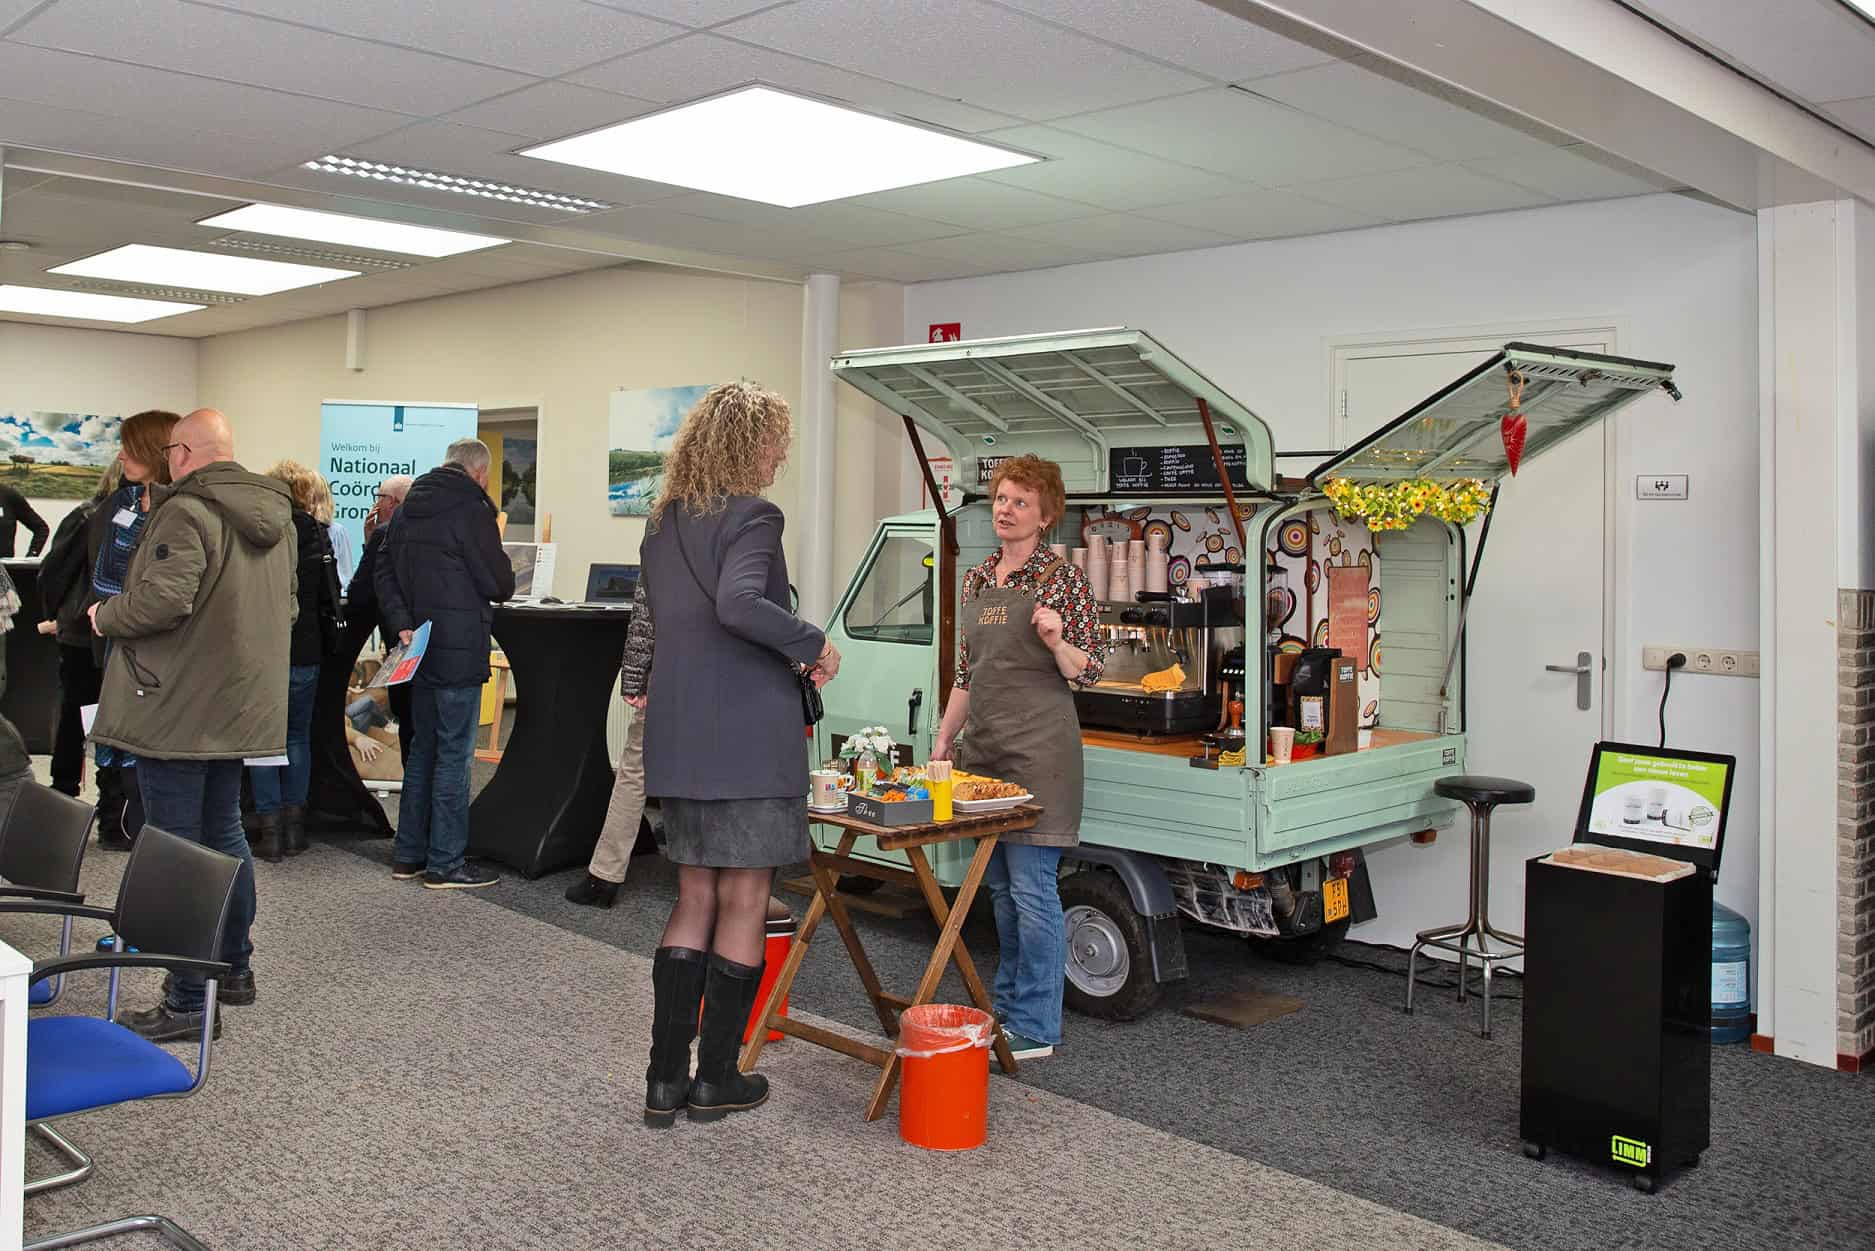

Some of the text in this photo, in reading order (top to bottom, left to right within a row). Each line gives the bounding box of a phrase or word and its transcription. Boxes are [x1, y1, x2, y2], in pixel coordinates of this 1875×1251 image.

[331, 442, 381, 454] Welkom bij
[330, 457, 416, 475] Nationaal
[983, 606, 1008, 616] TOFFE
[977, 615, 1008, 625] KOFFIE
